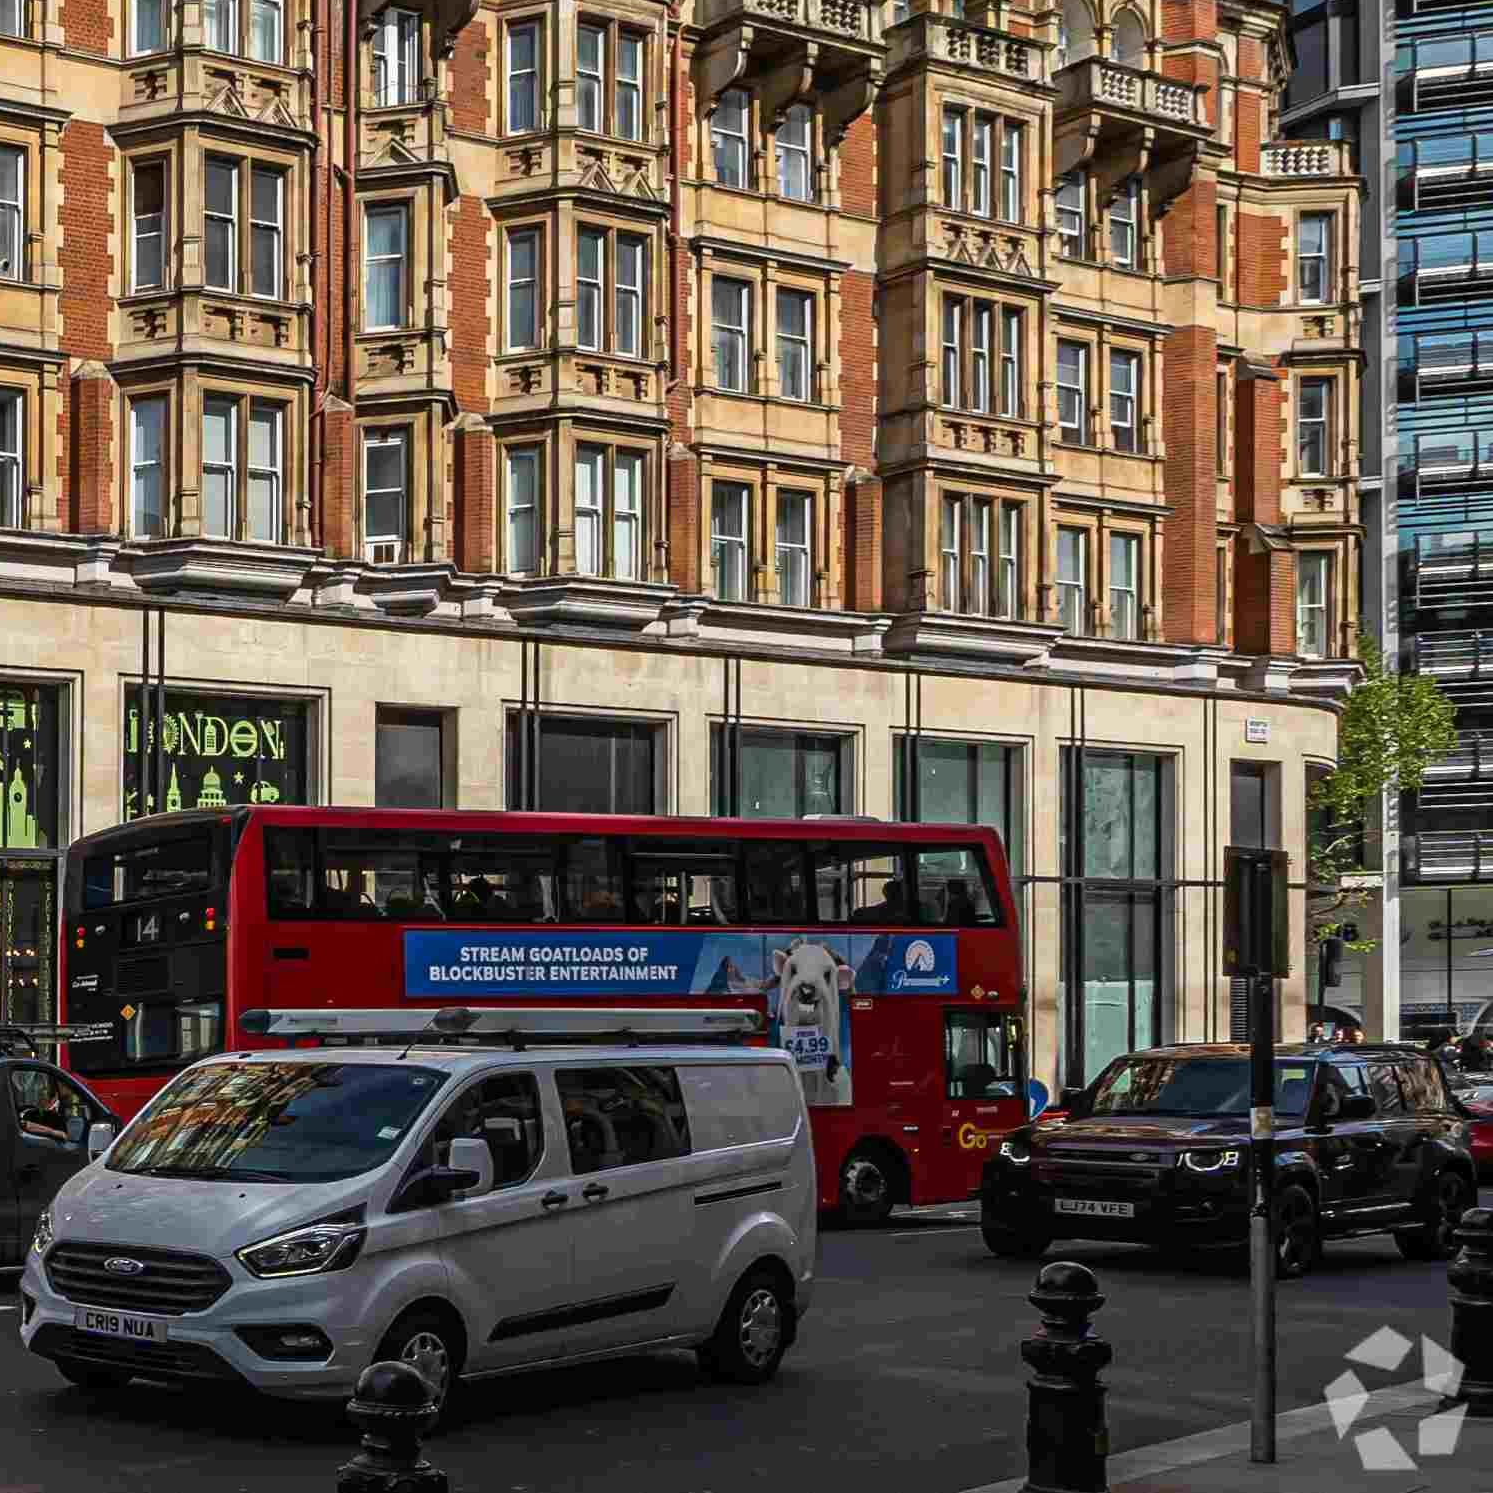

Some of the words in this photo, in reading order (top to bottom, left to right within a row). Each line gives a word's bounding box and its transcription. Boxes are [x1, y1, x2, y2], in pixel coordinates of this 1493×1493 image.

[136, 916, 160, 942] 14
[460, 947, 525, 962] STREAM
[529, 947, 624, 962] GOATLOADS
[628, 947, 648, 962] OF
[429, 965, 546, 981] BLOCKBUSTER
[550, 965, 678, 981] ENTERTAINMENT
[86, 1312, 120, 1333] CR19
[123, 1316, 155, 1337] NUA
